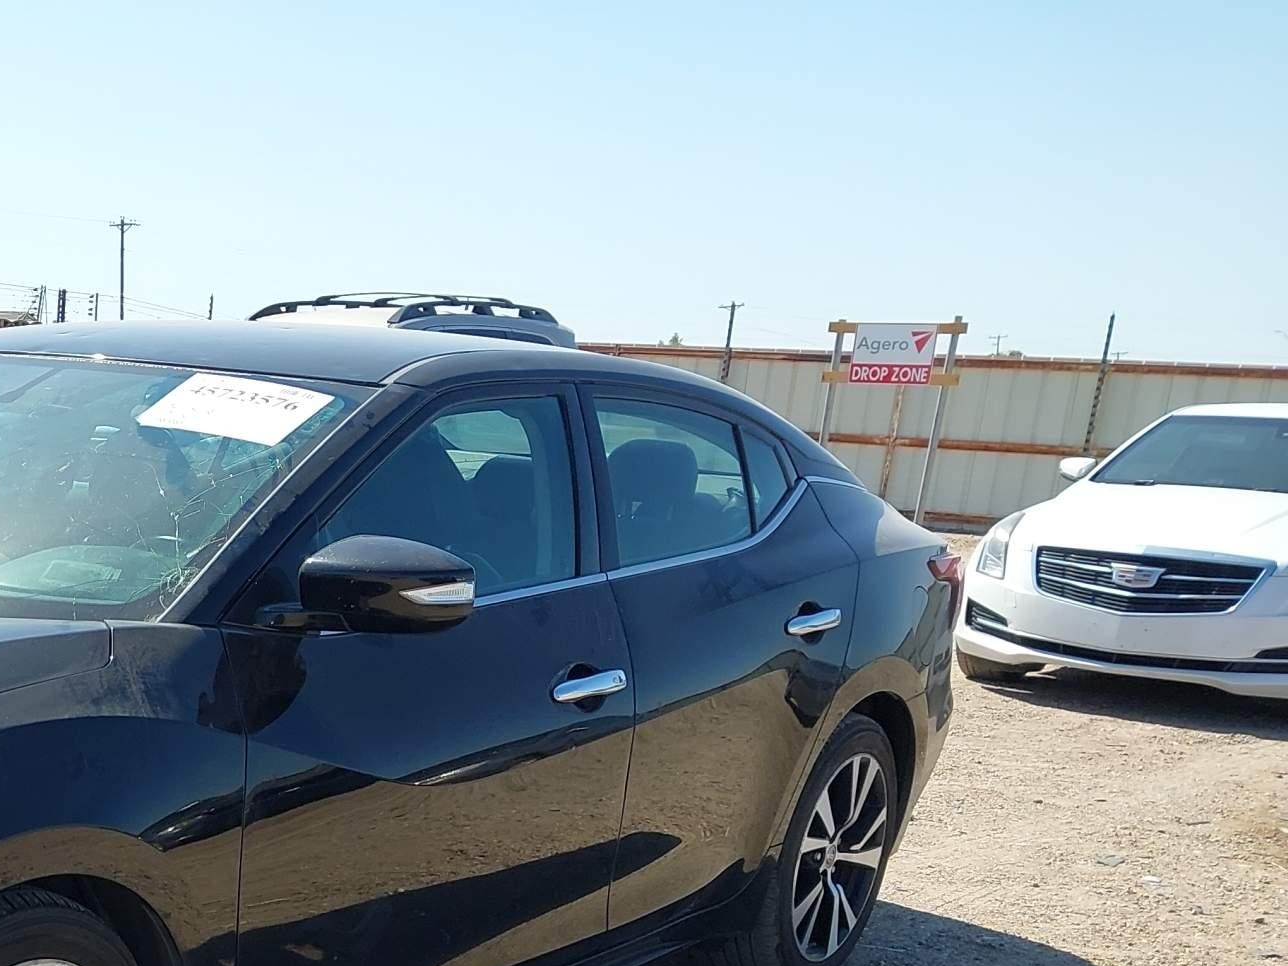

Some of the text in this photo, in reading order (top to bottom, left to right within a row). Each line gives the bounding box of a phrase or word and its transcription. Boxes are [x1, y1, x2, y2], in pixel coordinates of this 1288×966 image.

[857, 336, 910, 354] Agero
[851, 366, 929, 382] DROP ZONE
